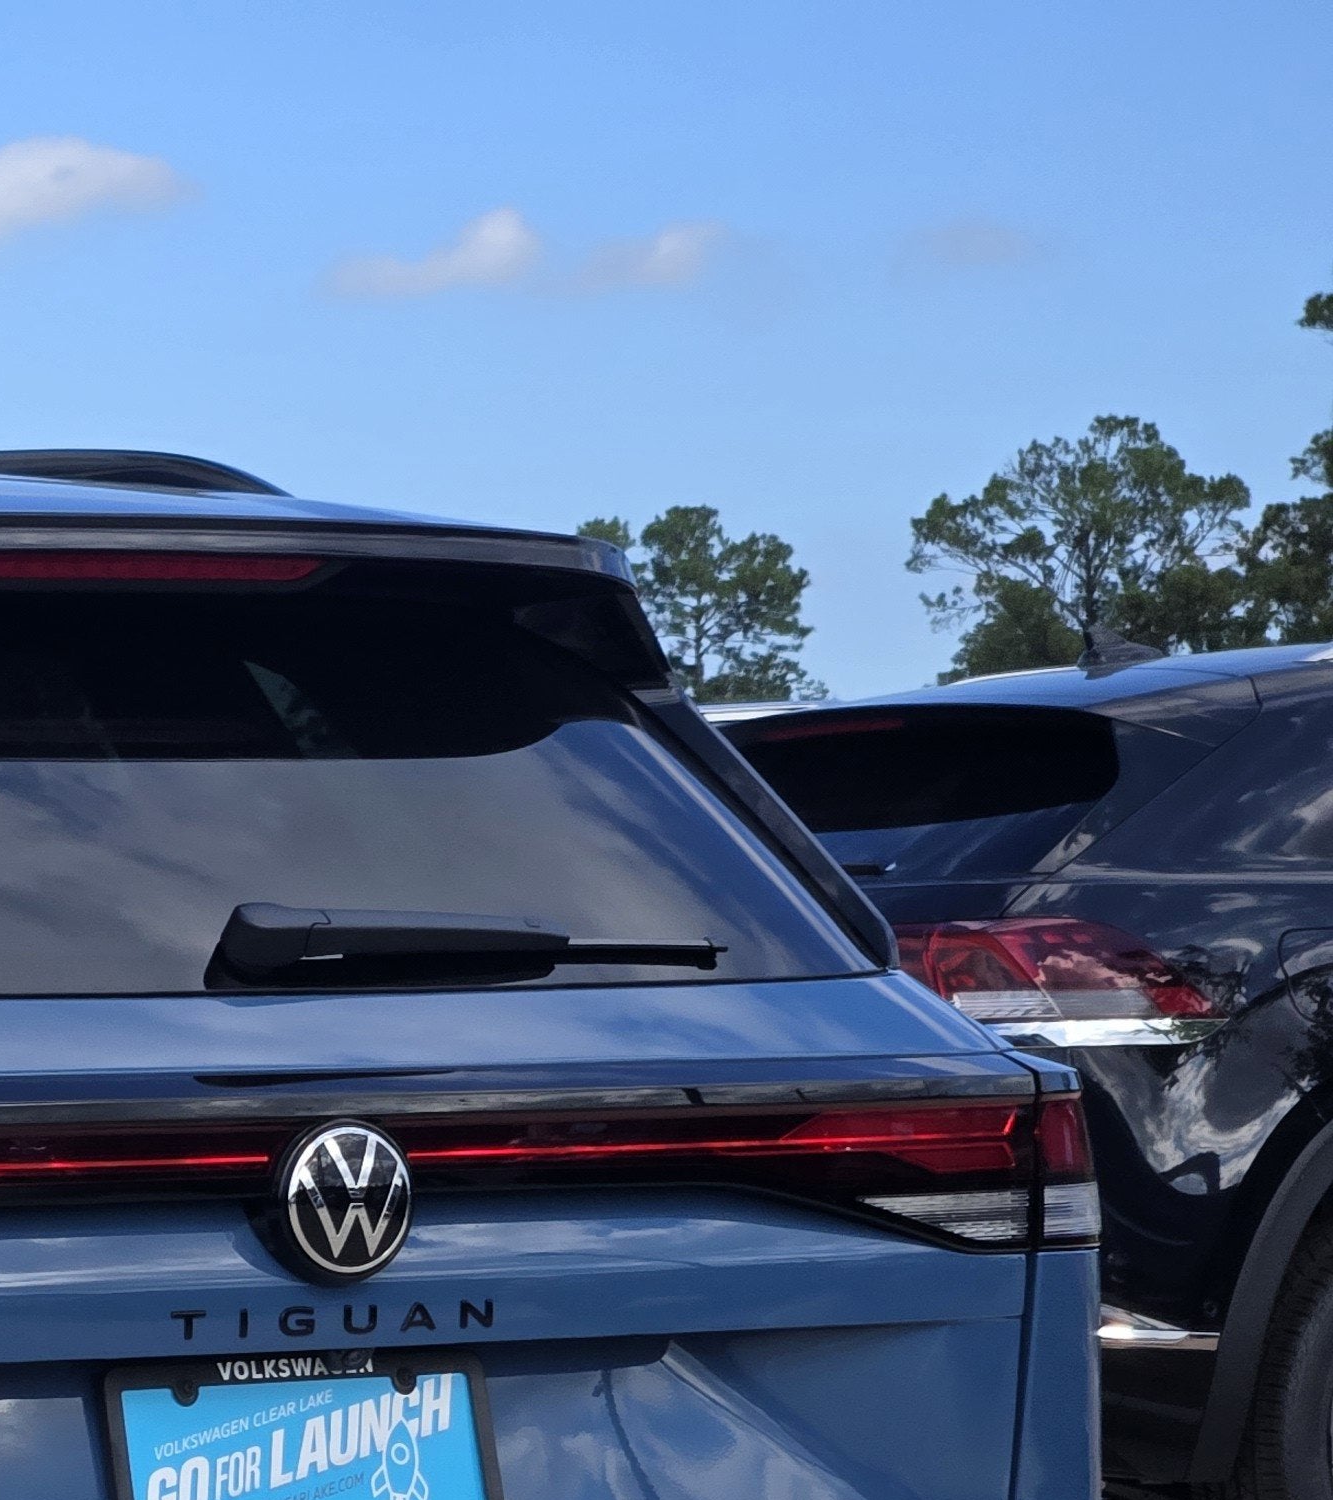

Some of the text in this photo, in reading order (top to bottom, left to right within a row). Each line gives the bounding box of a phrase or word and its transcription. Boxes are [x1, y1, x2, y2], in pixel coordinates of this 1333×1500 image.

[170, 1299, 494, 1340] TIGUAN
[217, 1356, 374, 1381] VOLKSWAN
[154, 1389, 333, 1461] VOLKSWAGEN CLEAR LAKE
[270, 1373, 453, 1489] LAUNCH
